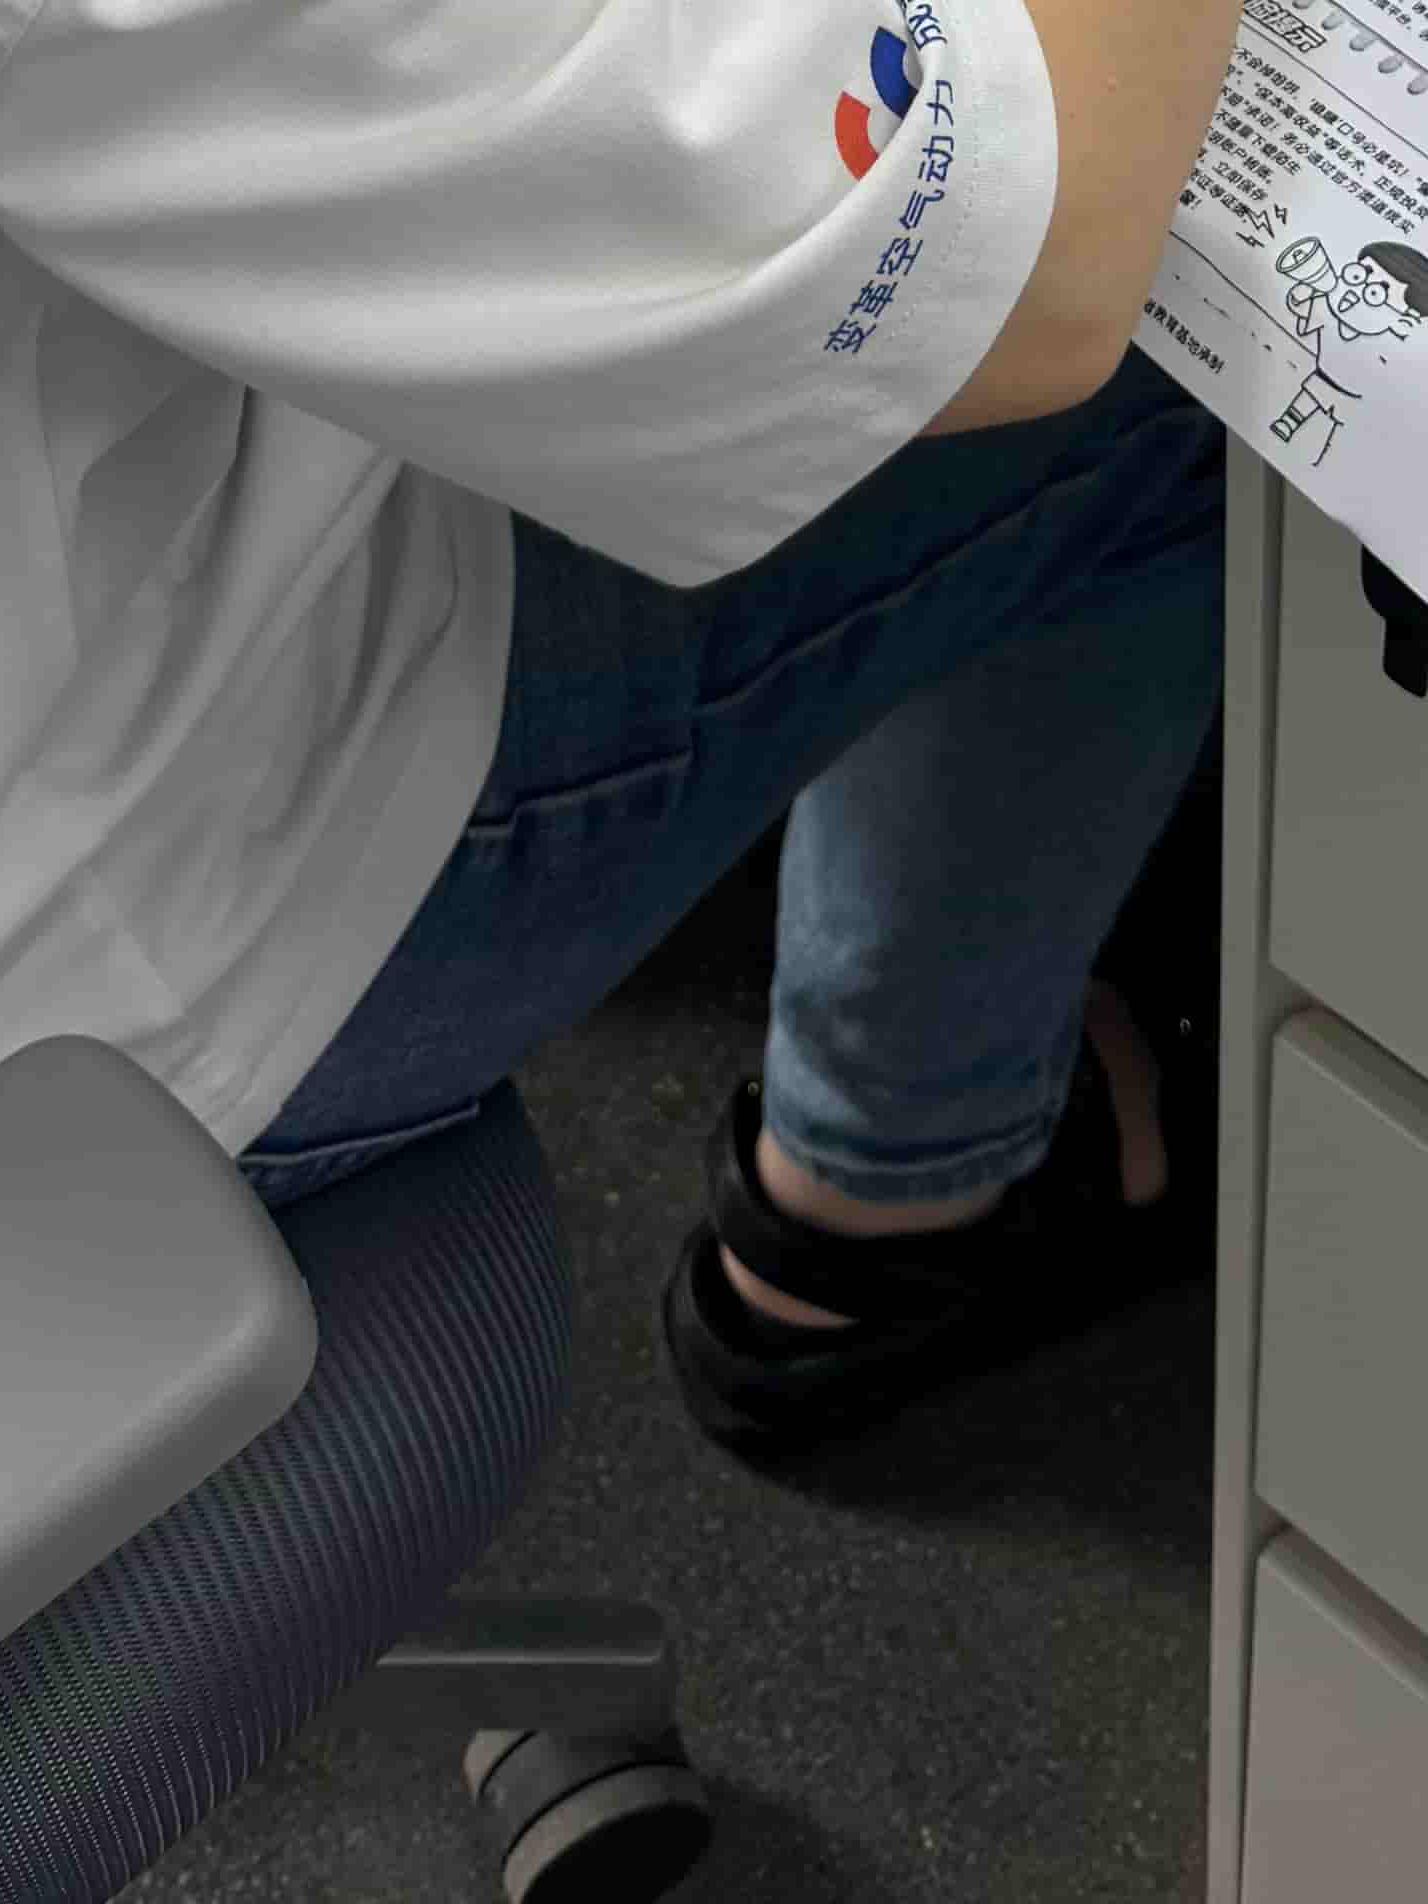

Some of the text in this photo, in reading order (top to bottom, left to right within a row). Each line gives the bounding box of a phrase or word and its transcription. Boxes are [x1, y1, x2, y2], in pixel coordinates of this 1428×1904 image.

[823, 79, 957, 355] 变革空气动力
